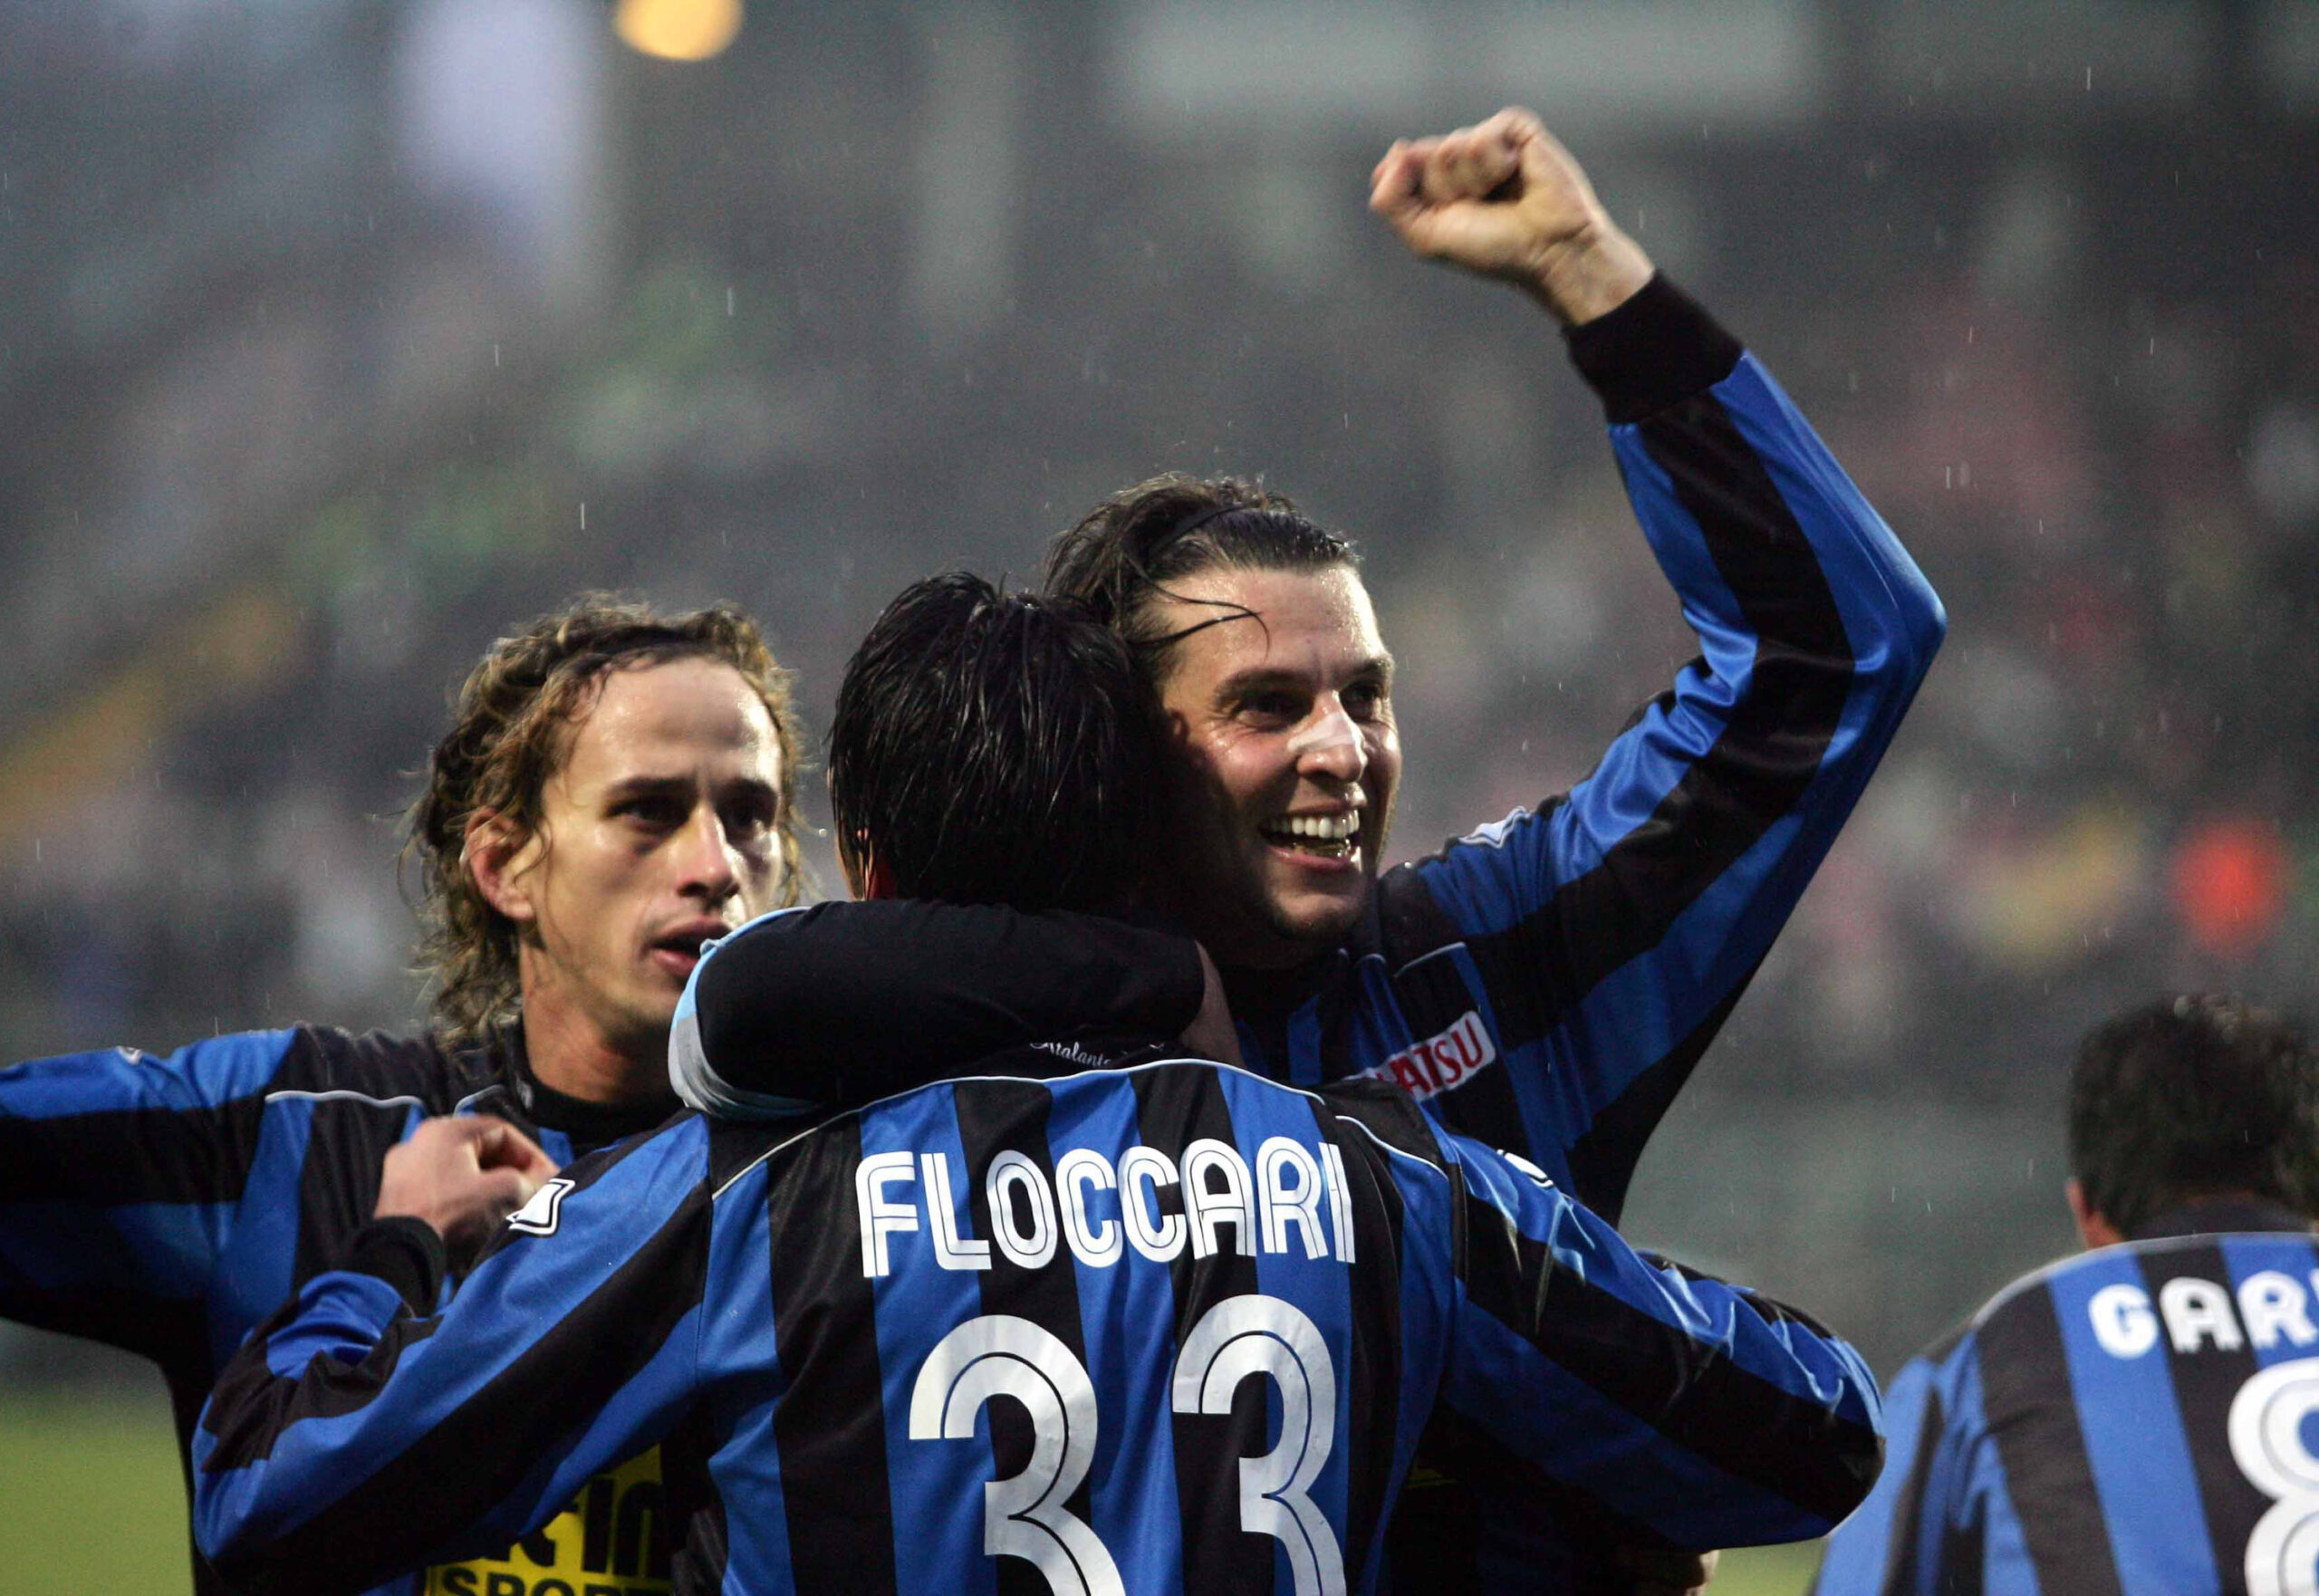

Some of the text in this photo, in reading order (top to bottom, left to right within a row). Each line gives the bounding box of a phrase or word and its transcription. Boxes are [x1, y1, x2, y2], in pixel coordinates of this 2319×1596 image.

[1375, 1017, 1484, 1094] ATSU
[854, 1135, 1357, 1279] FLOCCARI
[2087, 1268, 2319, 1360] GAR
[908, 1293, 1348, 1596] 33
